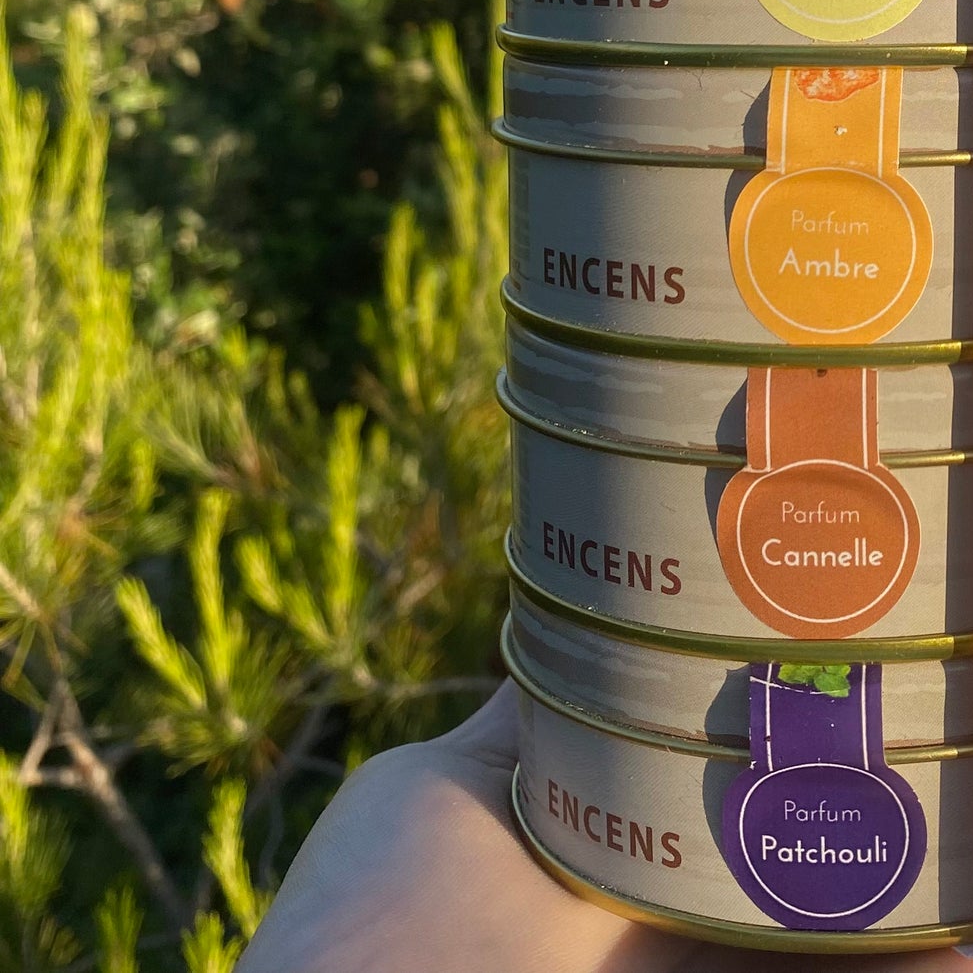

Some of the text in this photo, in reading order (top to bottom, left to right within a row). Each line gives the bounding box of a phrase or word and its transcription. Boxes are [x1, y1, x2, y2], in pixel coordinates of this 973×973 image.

[790, 210, 870, 235] Parfum
[543, 247, 686, 305] ENCENS
[778, 248, 880, 280] Ambre
[781, 502, 860, 525] Parfum
[542, 521, 681, 595] ENCENS
[761, 538, 884, 568] Cannelle
[548, 778, 683, 869] ENCENS
[784, 800, 861, 823] Parfum
[761, 835, 888, 865] Patchouli
